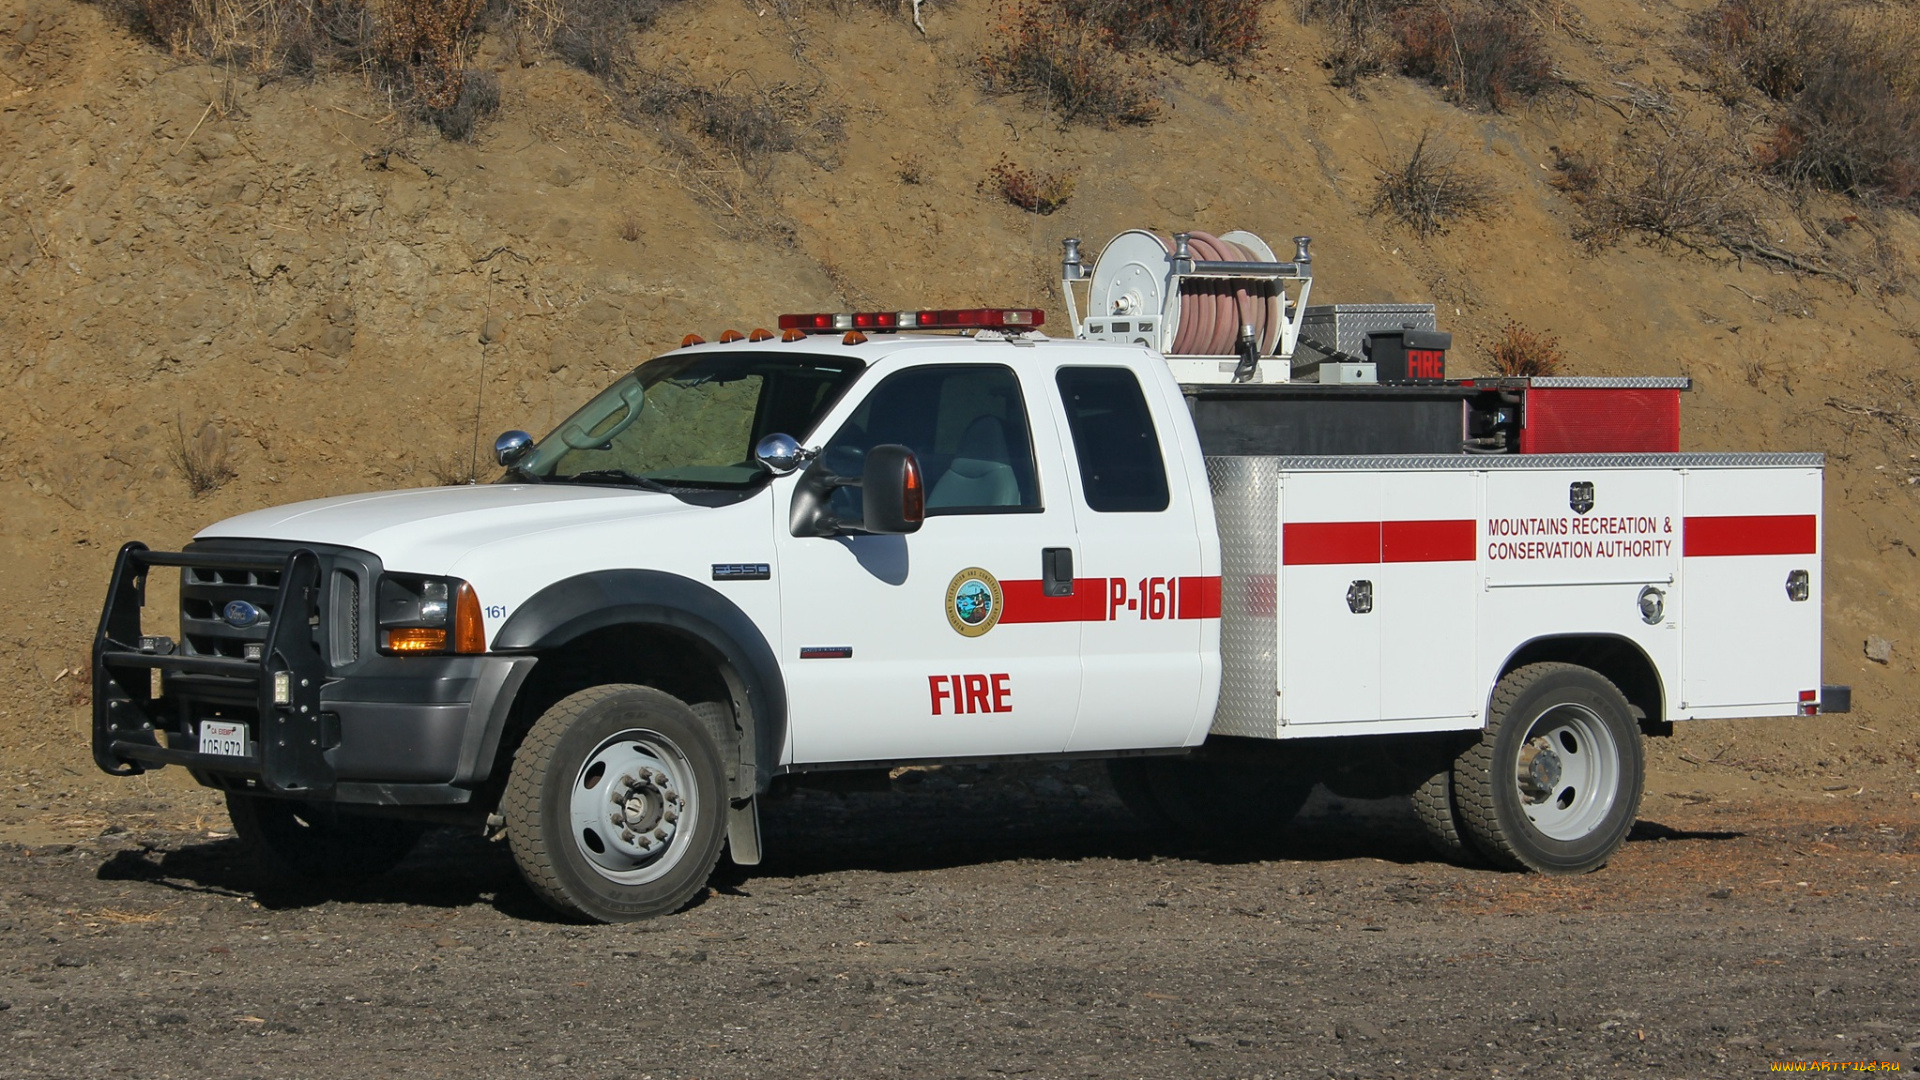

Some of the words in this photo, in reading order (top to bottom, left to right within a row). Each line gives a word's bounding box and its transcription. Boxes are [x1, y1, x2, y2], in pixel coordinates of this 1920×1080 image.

[1408, 350, 1443, 378] FIRE
[1488, 517, 1568, 536] MOUNTAINS
[1572, 516, 1656, 535] RECREATION
[1663, 516, 1672, 533] &
[1488, 540, 1592, 560] CONSERVATION
[1596, 539, 1672, 558] AUTHORITY
[1108, 577, 1178, 621] P-161
[485, 605, 506, 619] 161
[928, 673, 1013, 716] FIRE
[218, 728, 234, 736] EXEMPT
